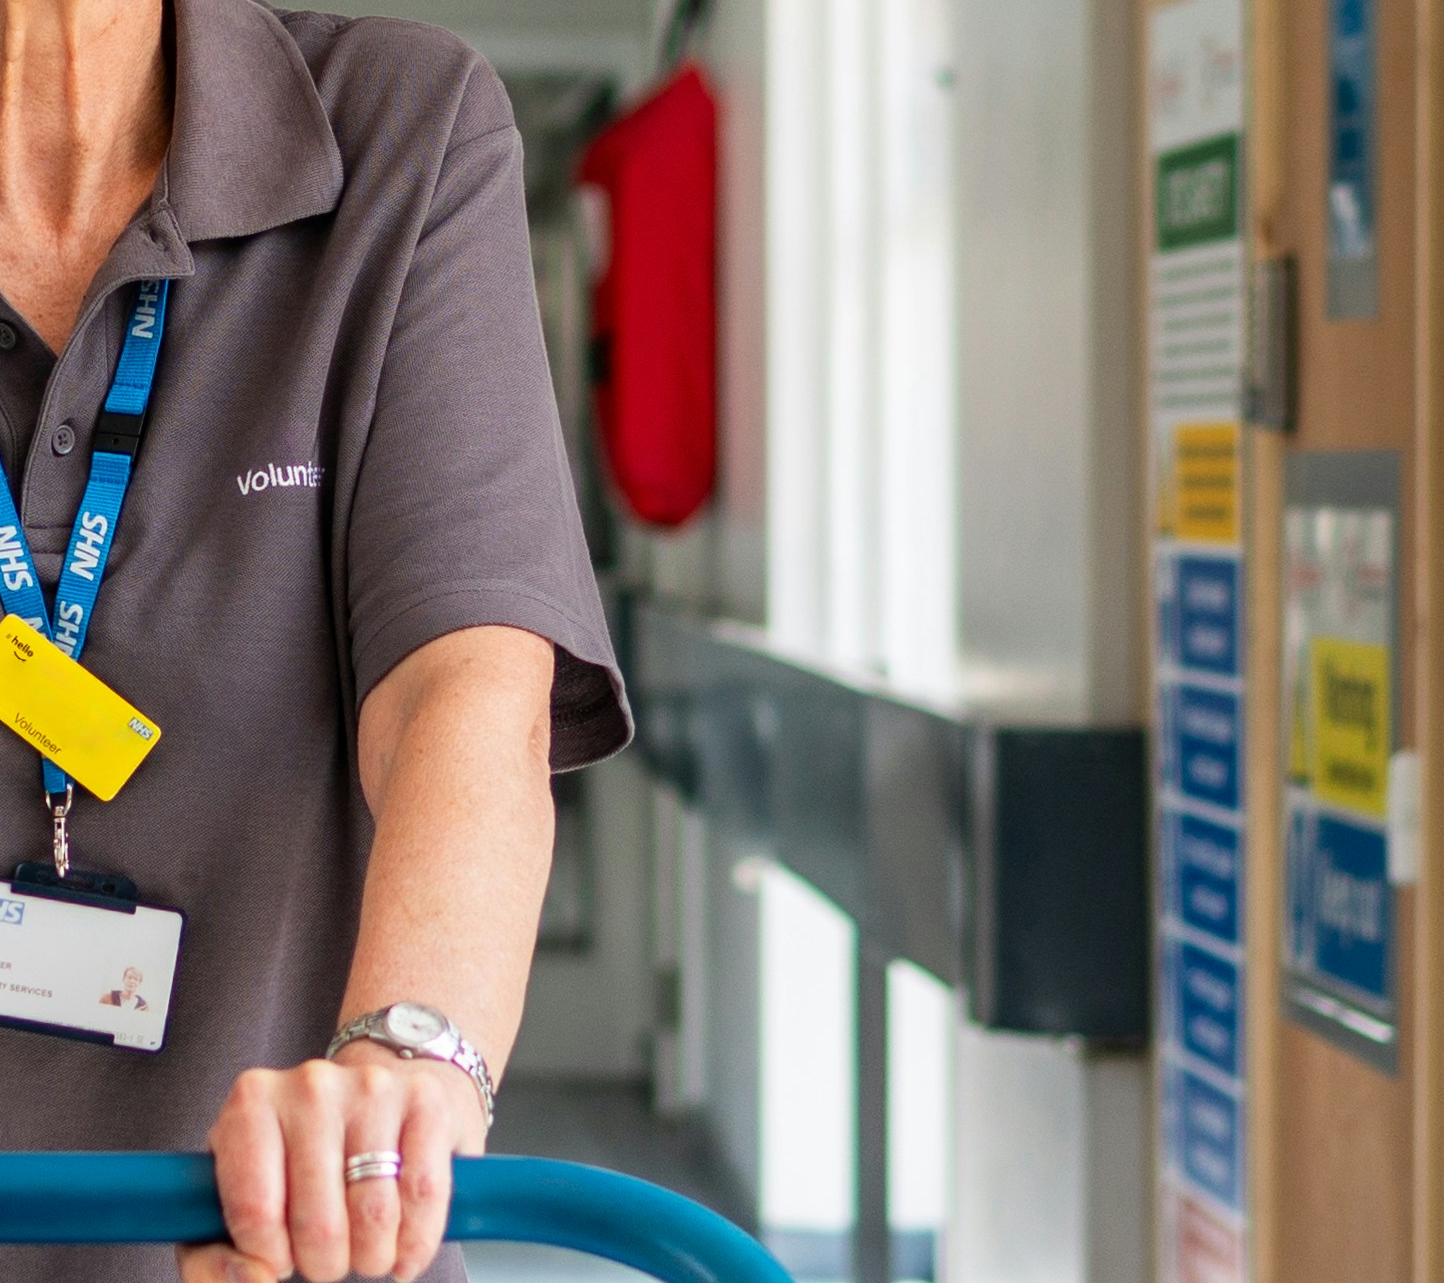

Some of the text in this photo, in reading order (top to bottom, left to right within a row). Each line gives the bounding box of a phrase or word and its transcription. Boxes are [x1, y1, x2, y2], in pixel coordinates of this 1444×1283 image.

[69, 511, 108, 582] NHS
[14, 712, 62, 756] Volunteer
[128, 717, 154, 741] NHS
[9, 983, 53, 998] SERVICES
